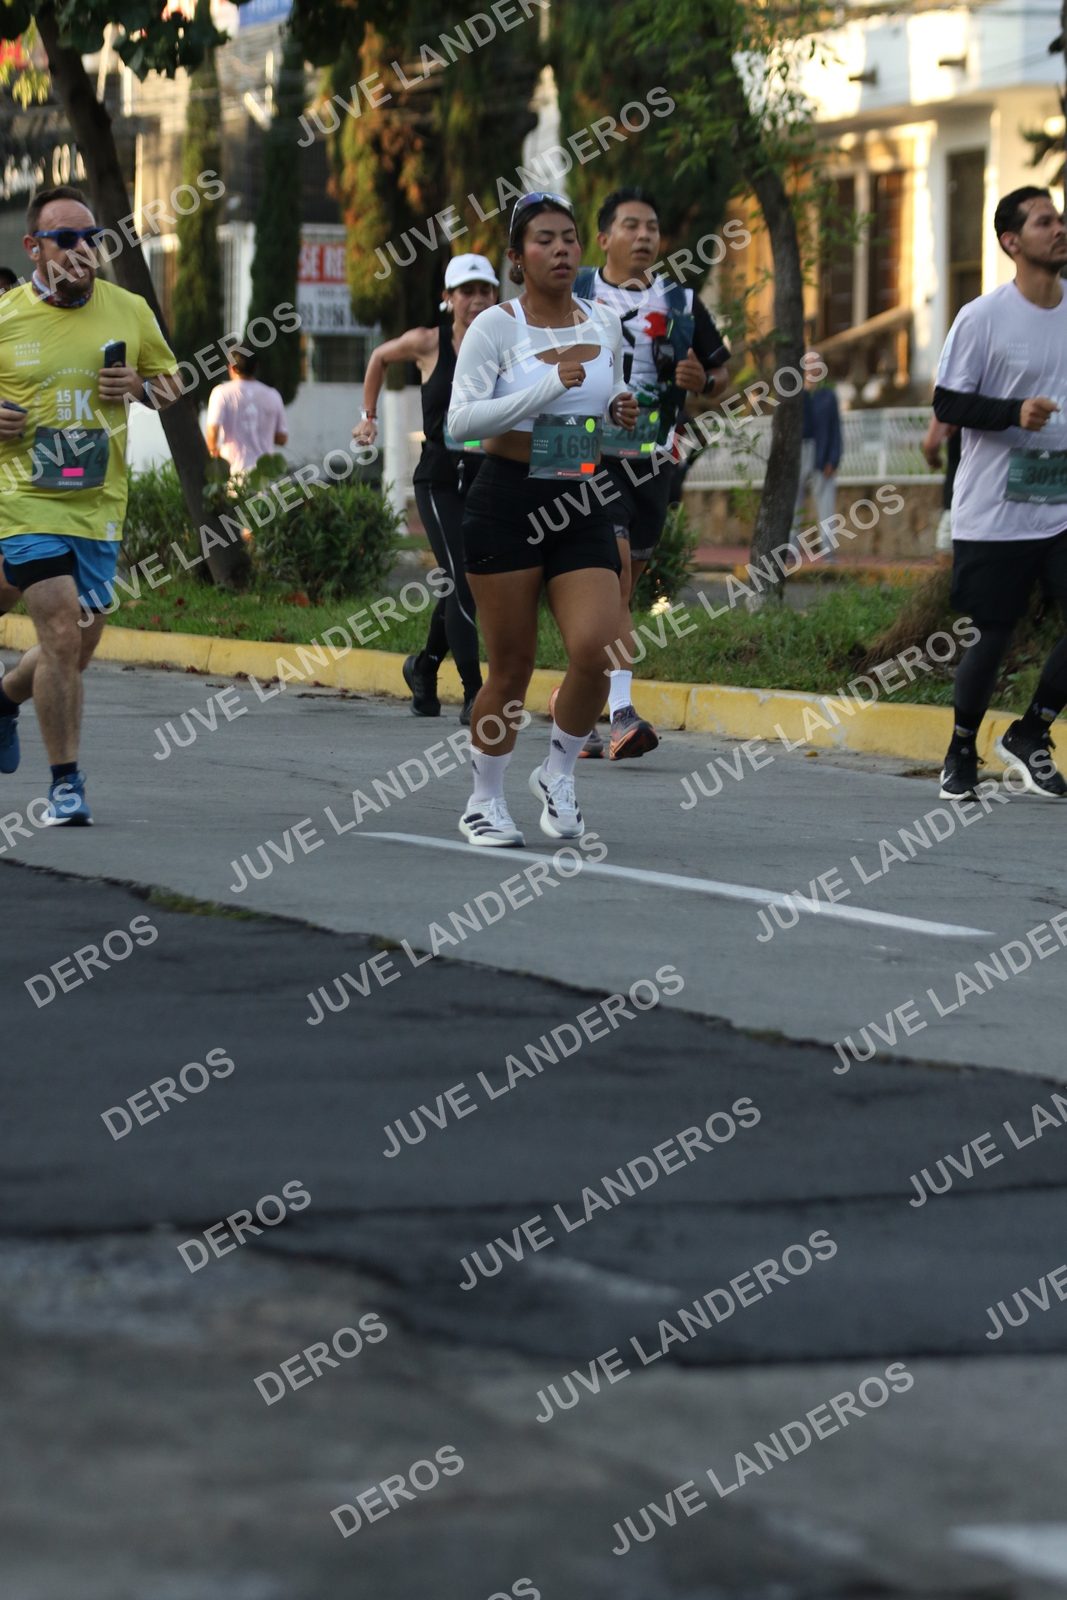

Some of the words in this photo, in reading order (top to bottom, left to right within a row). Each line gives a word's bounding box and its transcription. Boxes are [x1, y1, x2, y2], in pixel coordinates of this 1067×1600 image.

[56, 390, 71, 403] 15
[75, 389, 94, 421] K
[56, 408, 71, 421] 30
